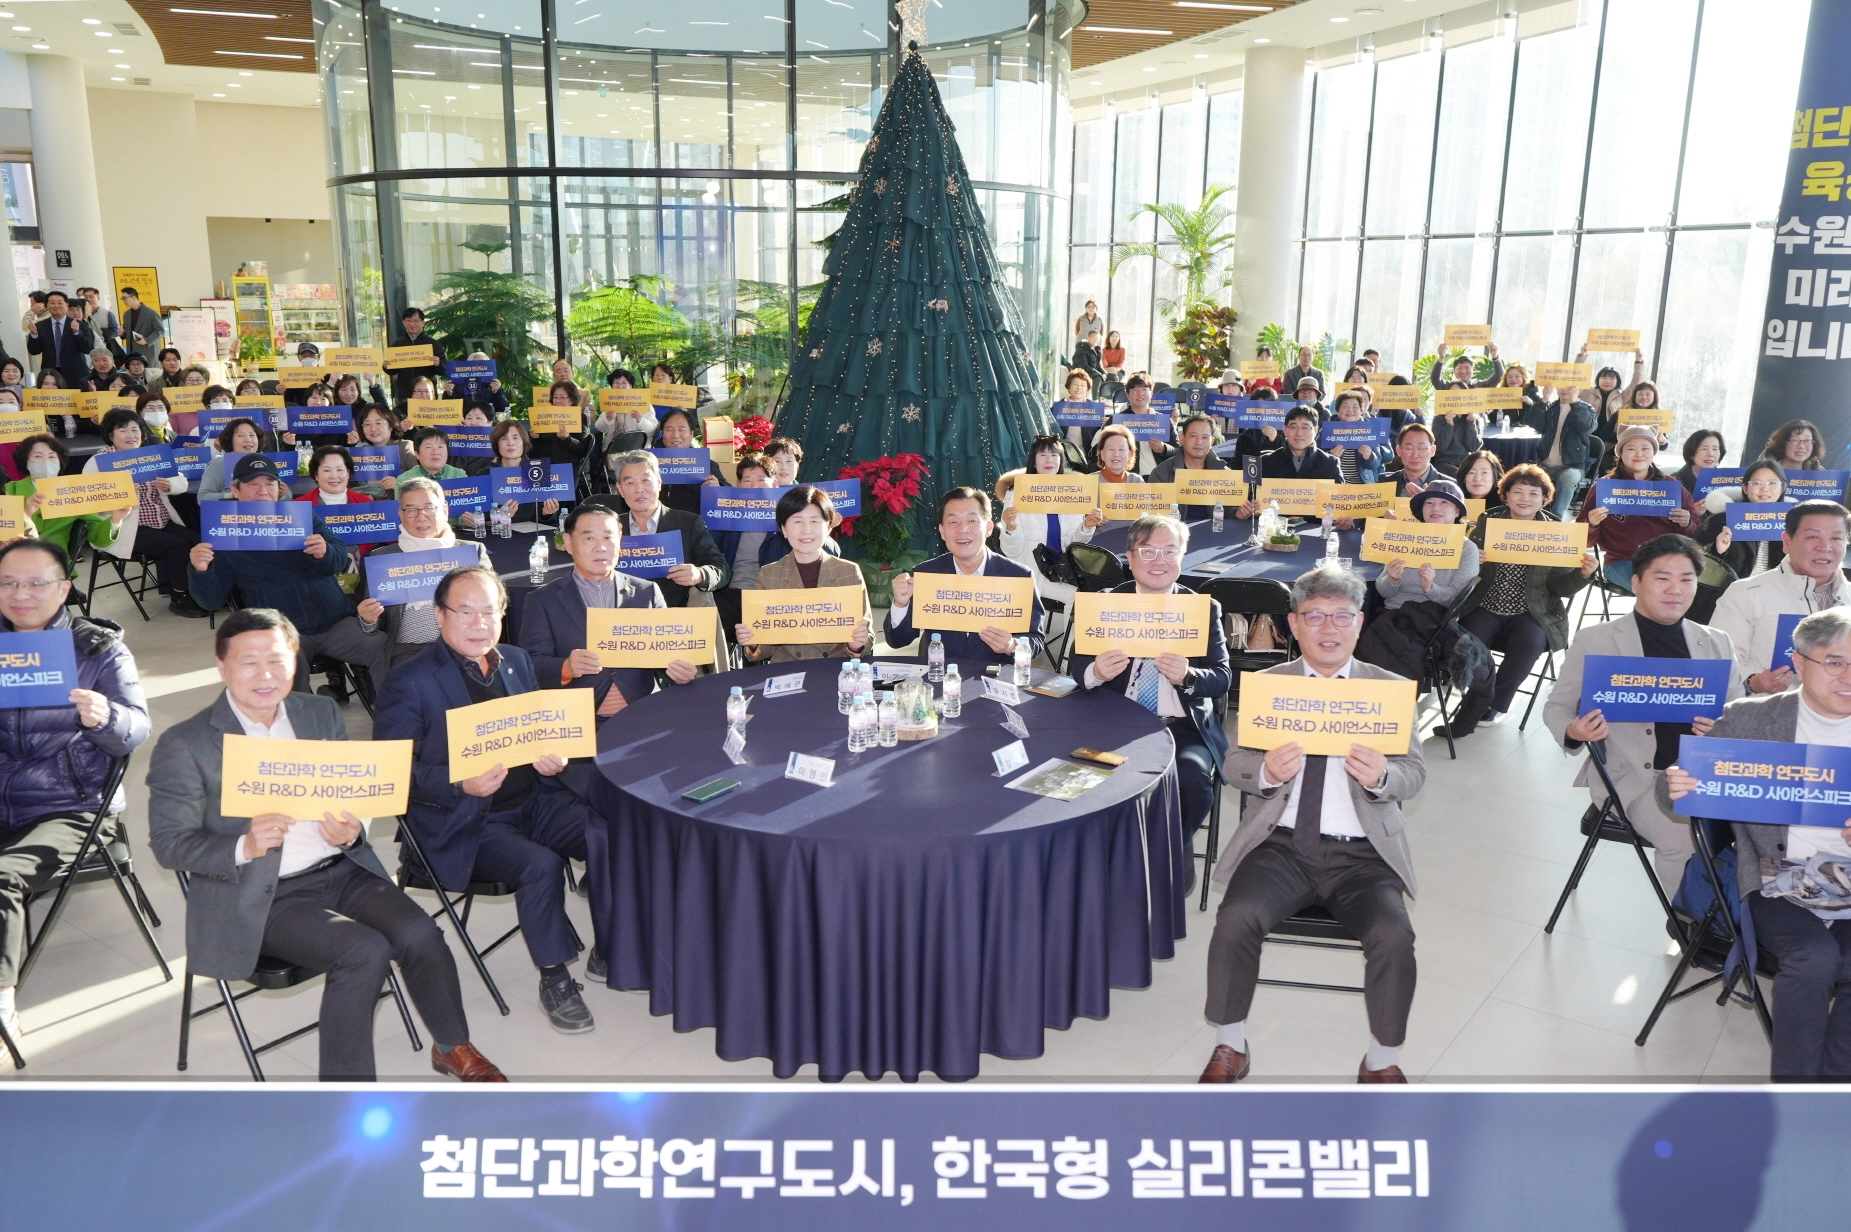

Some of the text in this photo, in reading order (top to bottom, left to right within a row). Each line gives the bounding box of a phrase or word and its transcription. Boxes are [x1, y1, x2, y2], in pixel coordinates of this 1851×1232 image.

[1802, 160, 1851, 201] 육
[1765, 318, 1851, 360] 입니
[56, 482, 116, 495] 첨단과학 연구도시
[48, 491, 129, 506] 수원 R&D 사이언스파크
[718, 498, 776, 508] 첨단과학 연구도시
[1636, 498, 1675, 506] 사이언스파크
[1353, 501, 1388, 510] 사이언스파크
[220, 514, 292, 524] 첨단과학 연구도시
[325, 513, 385, 524] 첨단과학 연구도시
[707, 509, 776, 520] 수원 R&D 사이언스파
[209, 526, 304, 537] 수원 R&D 사이언스파크
[333, 522, 396, 533] R&D 사이언스파크
[1752, 523, 1771, 531] R&D
[1383, 532, 1447, 545] 첨단과학 연구도시
[1505, 531, 1568, 541] 첨단과학 연구도시
[632, 547, 664, 556] 연구도시
[1371, 543, 1455, 556] 수원 R&D 사이언스파크
[1493, 543, 1578, 554] 수원 R&D 사이언스파크
[388, 561, 458, 577] 첨단과학 연구도시
[630, 558, 677, 568] 사이언스파크
[378, 579, 420, 591] 수원 R&D
[936, 590, 1011, 603] 첨단과학 연구도시
[766, 603, 842, 614] 첨단과학 연구도시
[922, 604, 1023, 617] 수원 R&D 사이언스파크
[752, 616, 854, 629] 수원 R&D 사이언스파크
[1100, 611, 1185, 623] 첨단과학 연구도시
[612, 624, 693, 636] 첨단과학 연구도시
[1085, 627, 1198, 639] 수원 R&D 사이언스파크
[598, 639, 706, 651] 수원 R&D 사이언스파크
[1611, 675, 1704, 689] 첨단과학 연구도시
[1593, 691, 1716, 705] 수원 R&D 사이언스파크
[1272, 697, 1382, 715] 첨단과학 연구도시
[476, 710, 565, 736] 첨단과학 연구도시
[1252, 715, 1398, 735] 수원 R&D 사이언스파크
[461, 727, 582, 758] 수원 R&D 사이언스파크
[259, 761, 376, 778] 첨단과학 연구도시
[1714, 761, 1835, 783] 첨단과학 연구도시
[237, 781, 394, 798] 수원 R&D 사이언스파크
[1693, 780, 1851, 805] 수원 R&D 사이언스파크
[419, 1136, 1430, 1206] 첨단과학연구도시, 한국형 실리콘밸리
